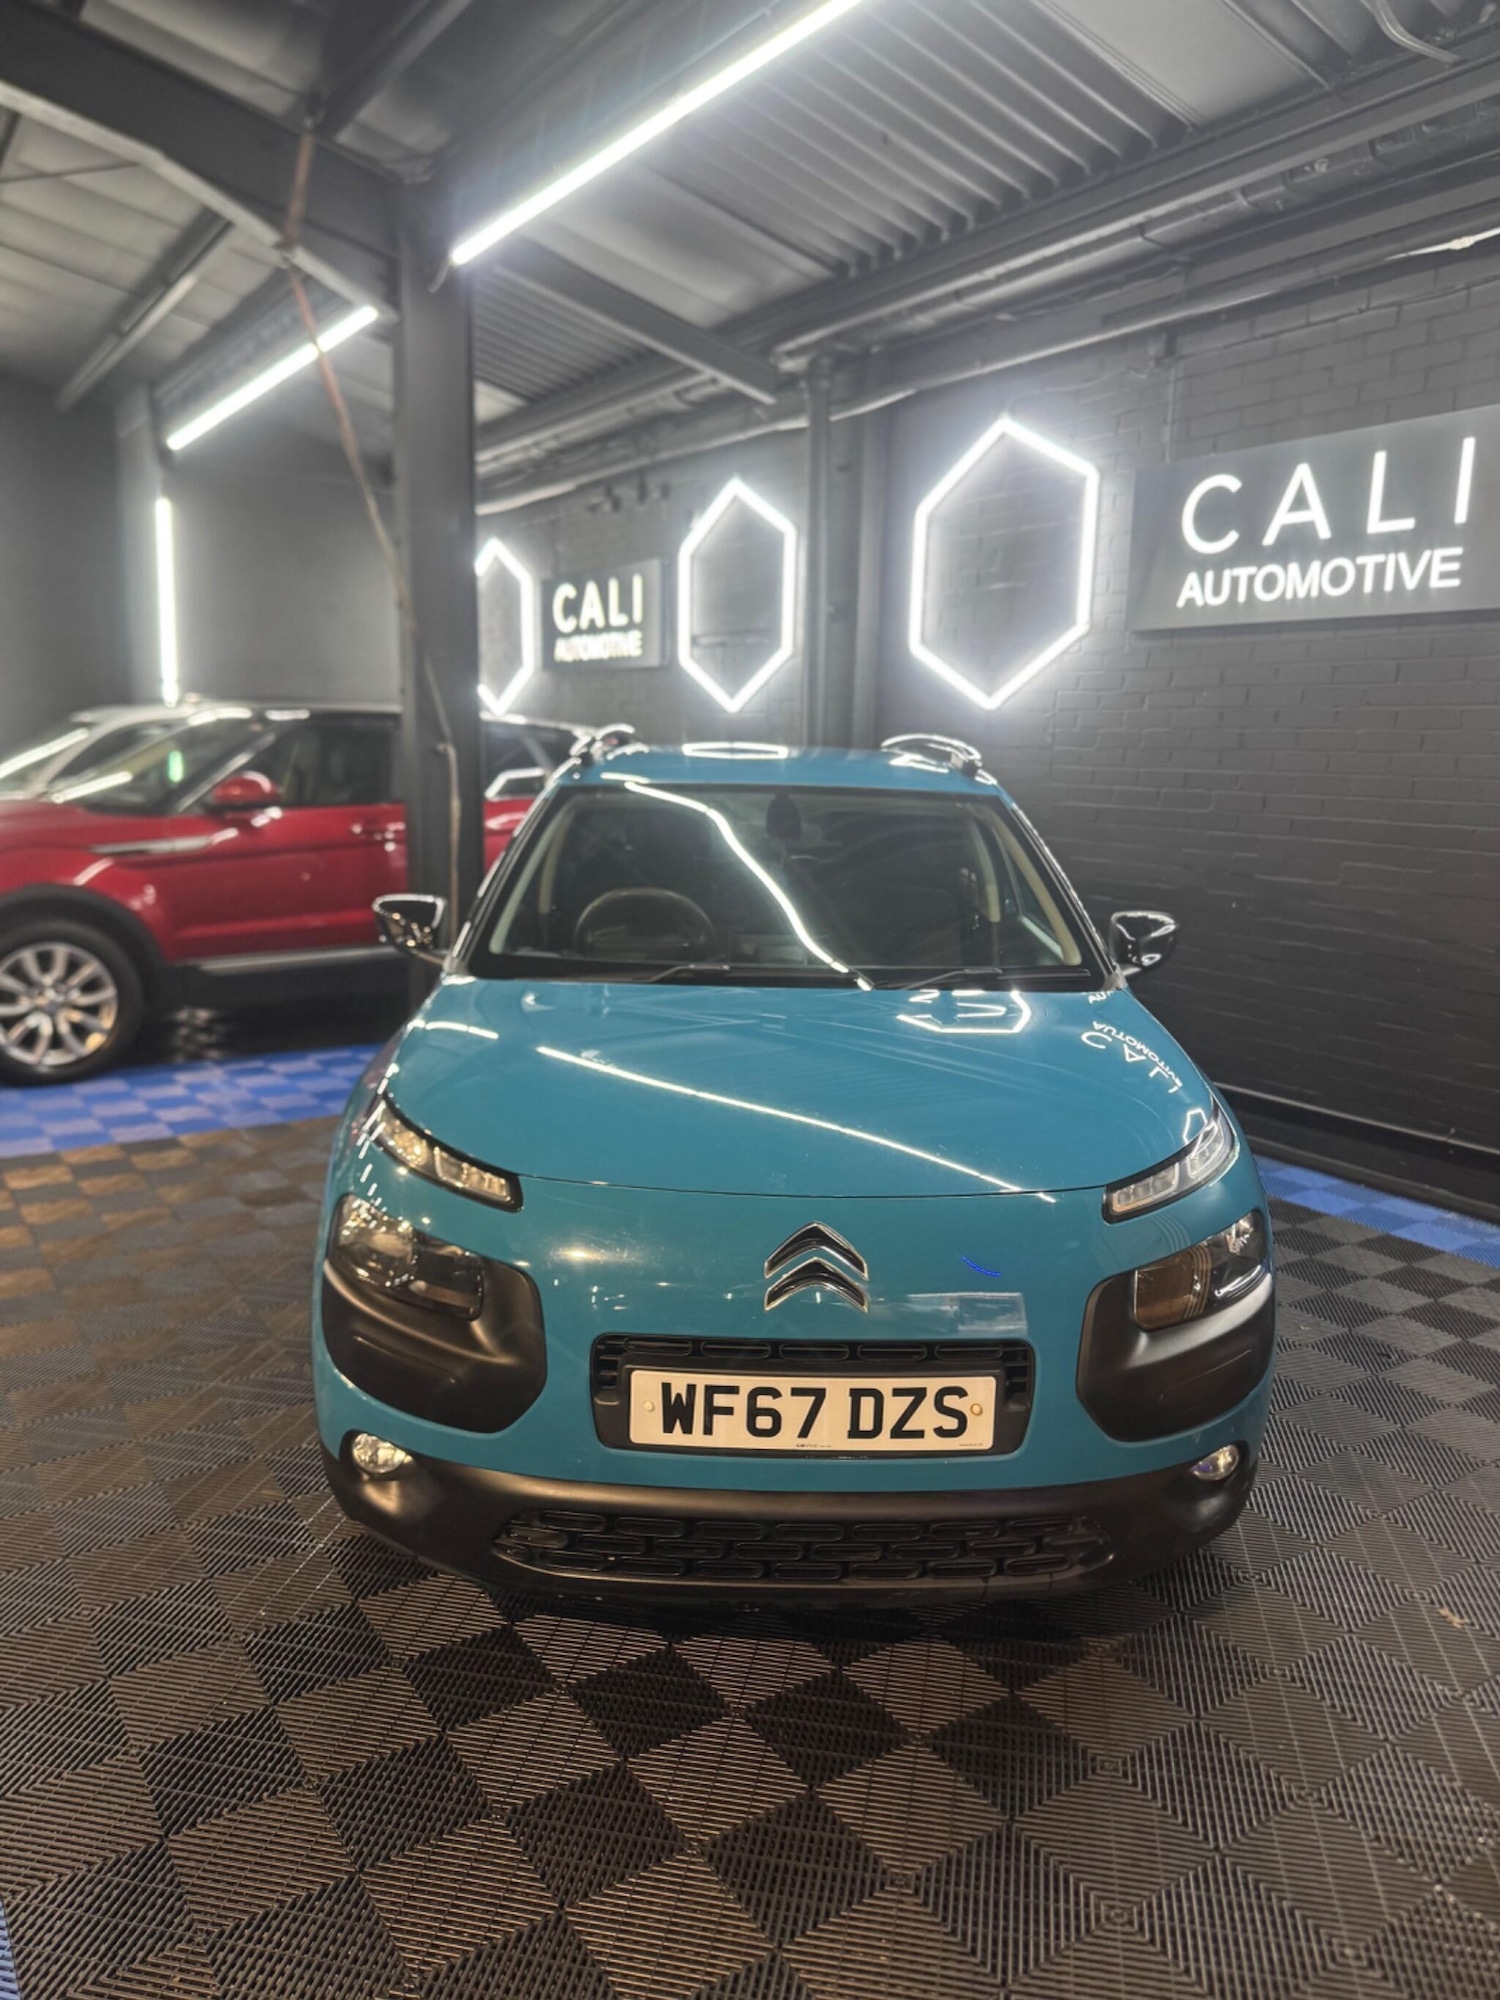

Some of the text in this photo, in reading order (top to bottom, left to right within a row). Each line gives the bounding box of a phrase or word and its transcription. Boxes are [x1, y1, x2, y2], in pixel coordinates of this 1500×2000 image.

[1181, 436, 1476, 554] CALI
[552, 574, 643, 634] CALI
[1176, 546, 1463, 608] AUTOMOTIVE
[661, 1382, 969, 1440] WF67 DZS
